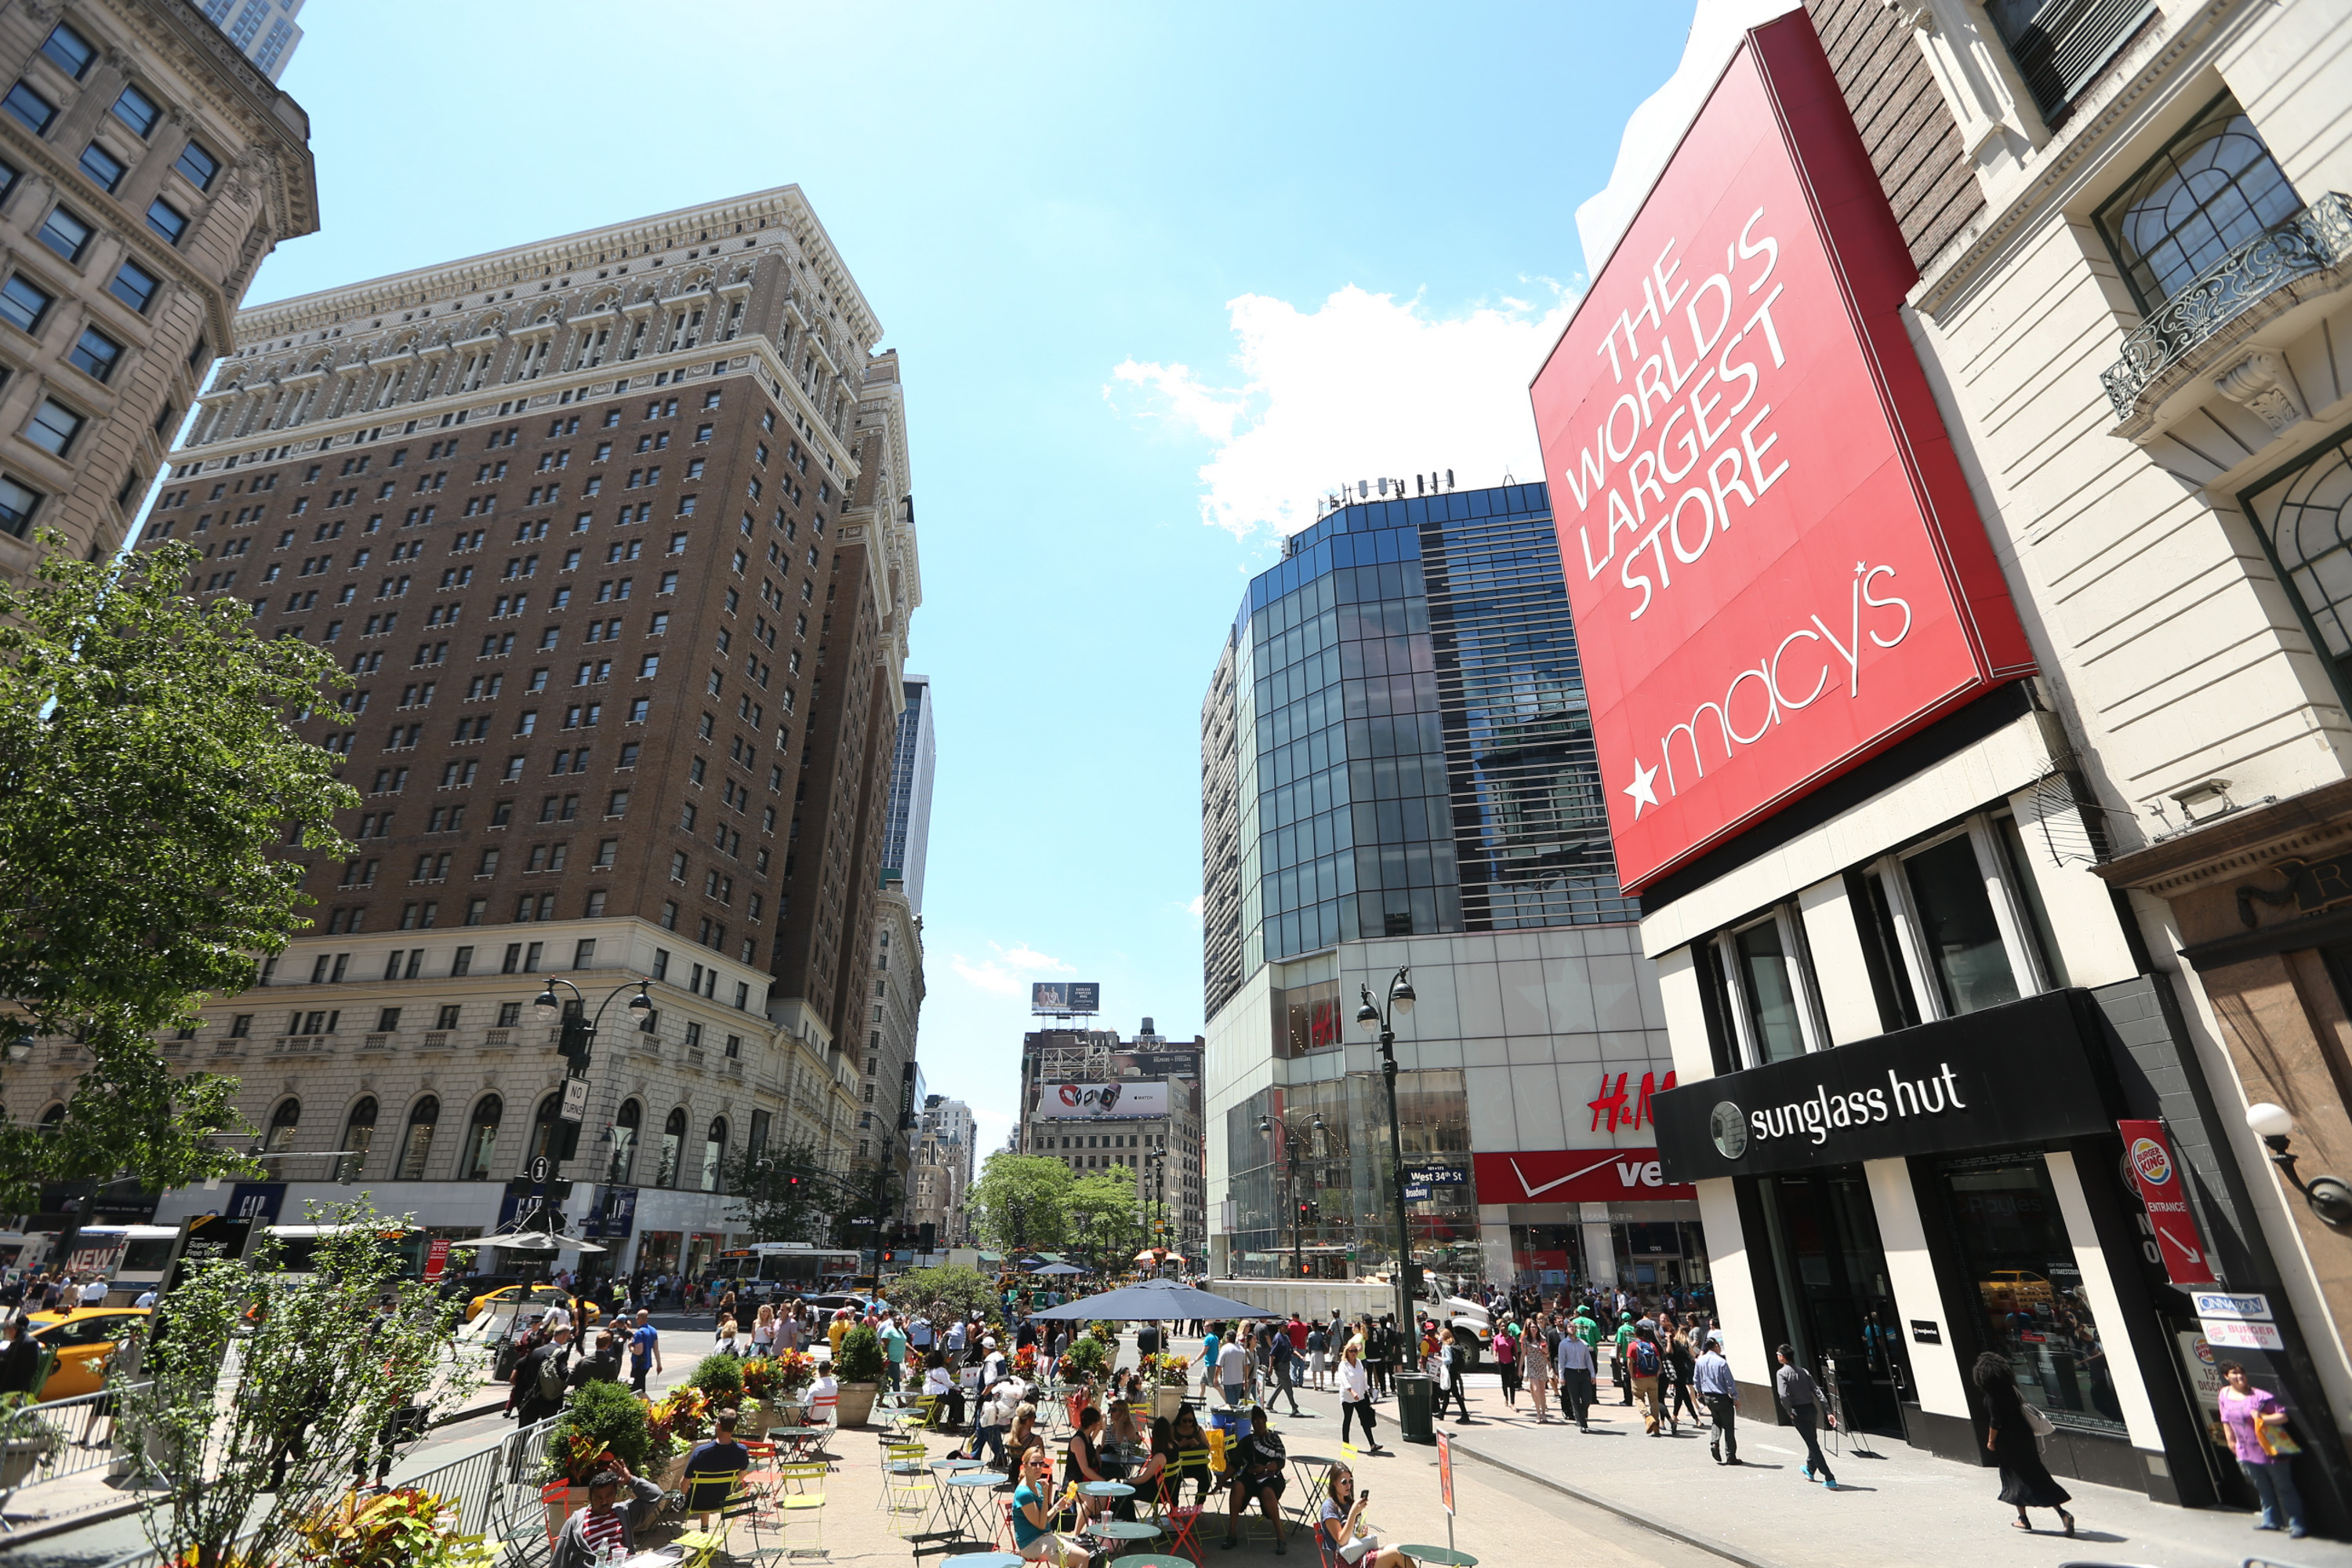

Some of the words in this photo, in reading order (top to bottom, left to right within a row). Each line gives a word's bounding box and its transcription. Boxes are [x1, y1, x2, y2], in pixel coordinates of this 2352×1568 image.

[1596, 236, 1691, 383] THE
[1565, 205, 1780, 514] WORLD'S
[1579, 281, 1787, 582] LARGEST
[1621, 402, 1791, 622] STORE
[570, 1085, 582, 1099] NO
[902, 1080, 912, 1113] Radisson
[563, 1102, 583, 1116] TURNS
[1751, 1084, 1888, 1145] sunglass
[1889, 1062, 1966, 1117] hut
[2136, 1147, 2161, 1163] BURGER
[2140, 1154, 2165, 1174] KING
[1411, 1172, 1433, 1181] West
[1436, 1171, 1450, 1181] 34th
[1453, 1172, 1462, 1181] St
[1406, 1187, 1428, 1198] Broadway
[238, 1196, 266, 1217] GAP
[2147, 1201, 2187, 1212] ENTRANCE
[64, 1248, 116, 1271] NEW
[2199, 1296, 2263, 1312] CINNABON
[2227, 1324, 2274, 1335] BURGER
[2240, 1335, 2268, 1345] KING
[2198, 1348, 2212, 1359] KIN
[2198, 1380, 2222, 1392] DISCO
